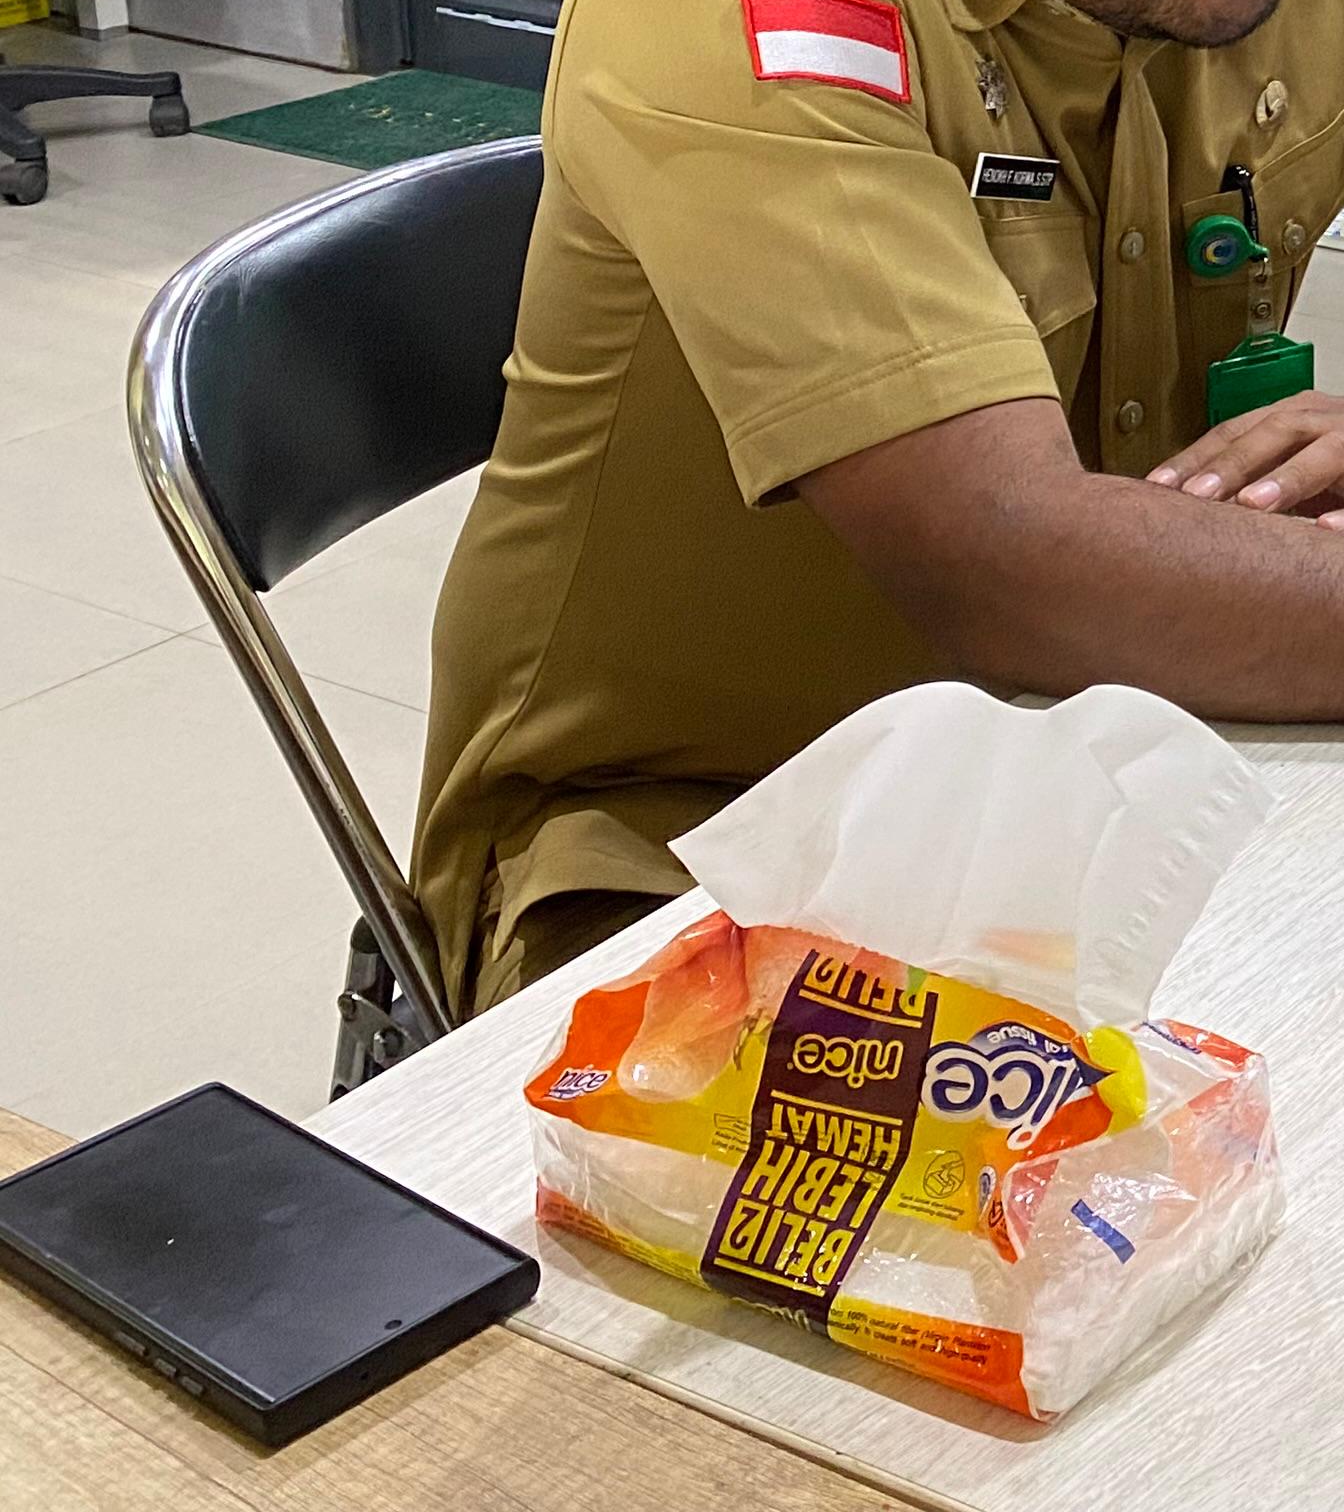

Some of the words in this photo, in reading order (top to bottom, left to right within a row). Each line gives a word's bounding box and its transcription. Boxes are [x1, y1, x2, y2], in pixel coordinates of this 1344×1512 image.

[793, 1034, 904, 1089] nice
[986, 1025, 1038, 1046] tissue
[550, 1064, 613, 1092] nice
[766, 1103, 901, 1171] HEMAT
[741, 1139, 886, 1229] LEBIH
[754, 1208, 856, 1286] BELI
[847, 1310, 868, 1324] 100%
